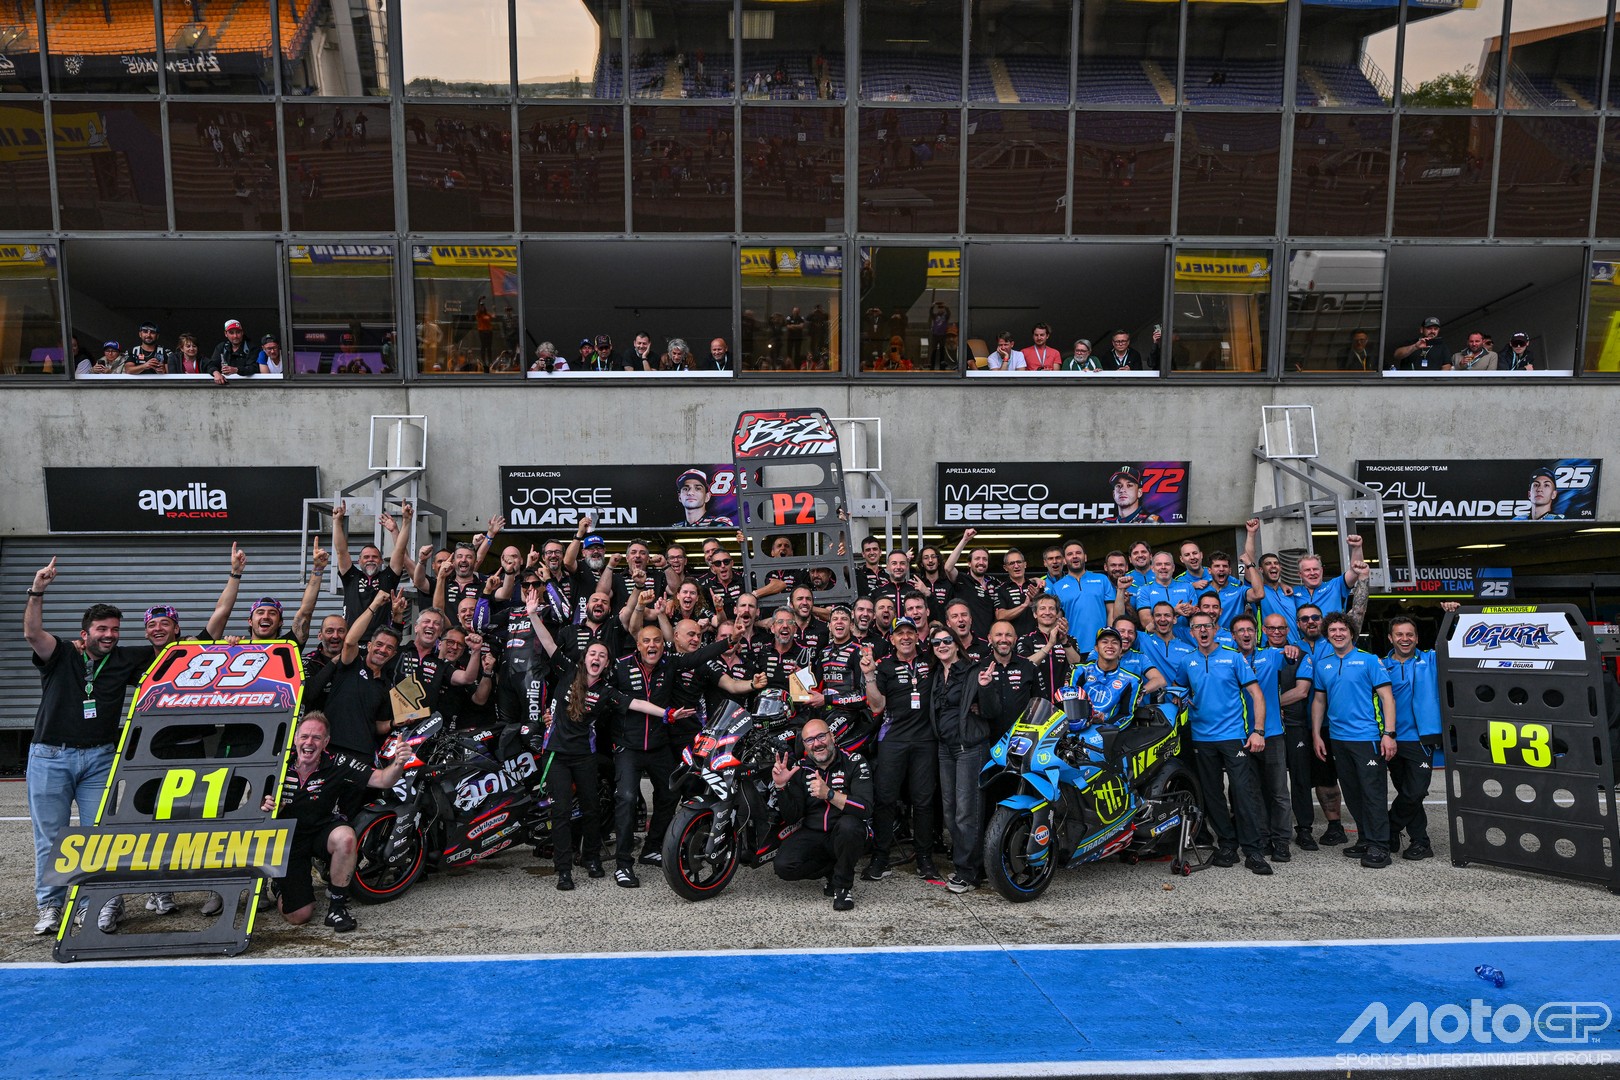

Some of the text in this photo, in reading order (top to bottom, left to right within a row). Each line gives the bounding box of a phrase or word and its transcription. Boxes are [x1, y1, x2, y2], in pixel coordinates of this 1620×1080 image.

[739, 418, 835, 452] BEZ
[1141, 468, 1185, 494] 72
[1364, 481, 1437, 498] RAUL
[1555, 467, 1595, 489] 25
[138, 482, 228, 516] aprilia
[510, 488, 612, 505] JORGE
[945, 484, 1049, 501] MARCO
[510, 507, 637, 525] MARTIN
[772, 492, 815, 525] P2
[944, 503, 1115, 520] BEZZECCHI
[1383, 500, 1532, 517] RNANDEZ
[1396, 580, 1475, 591] TOGP TEAM
[1480, 581, 1509, 597] 25
[1463, 622, 1558, 651] OGURA
[173, 652, 269, 688] 89
[527, 680, 541, 721] aprilia
[838, 693, 862, 705] aprilia
[1489, 721, 1552, 768] P3
[458, 751, 538, 800] aprilia
[155, 767, 229, 820] P1
